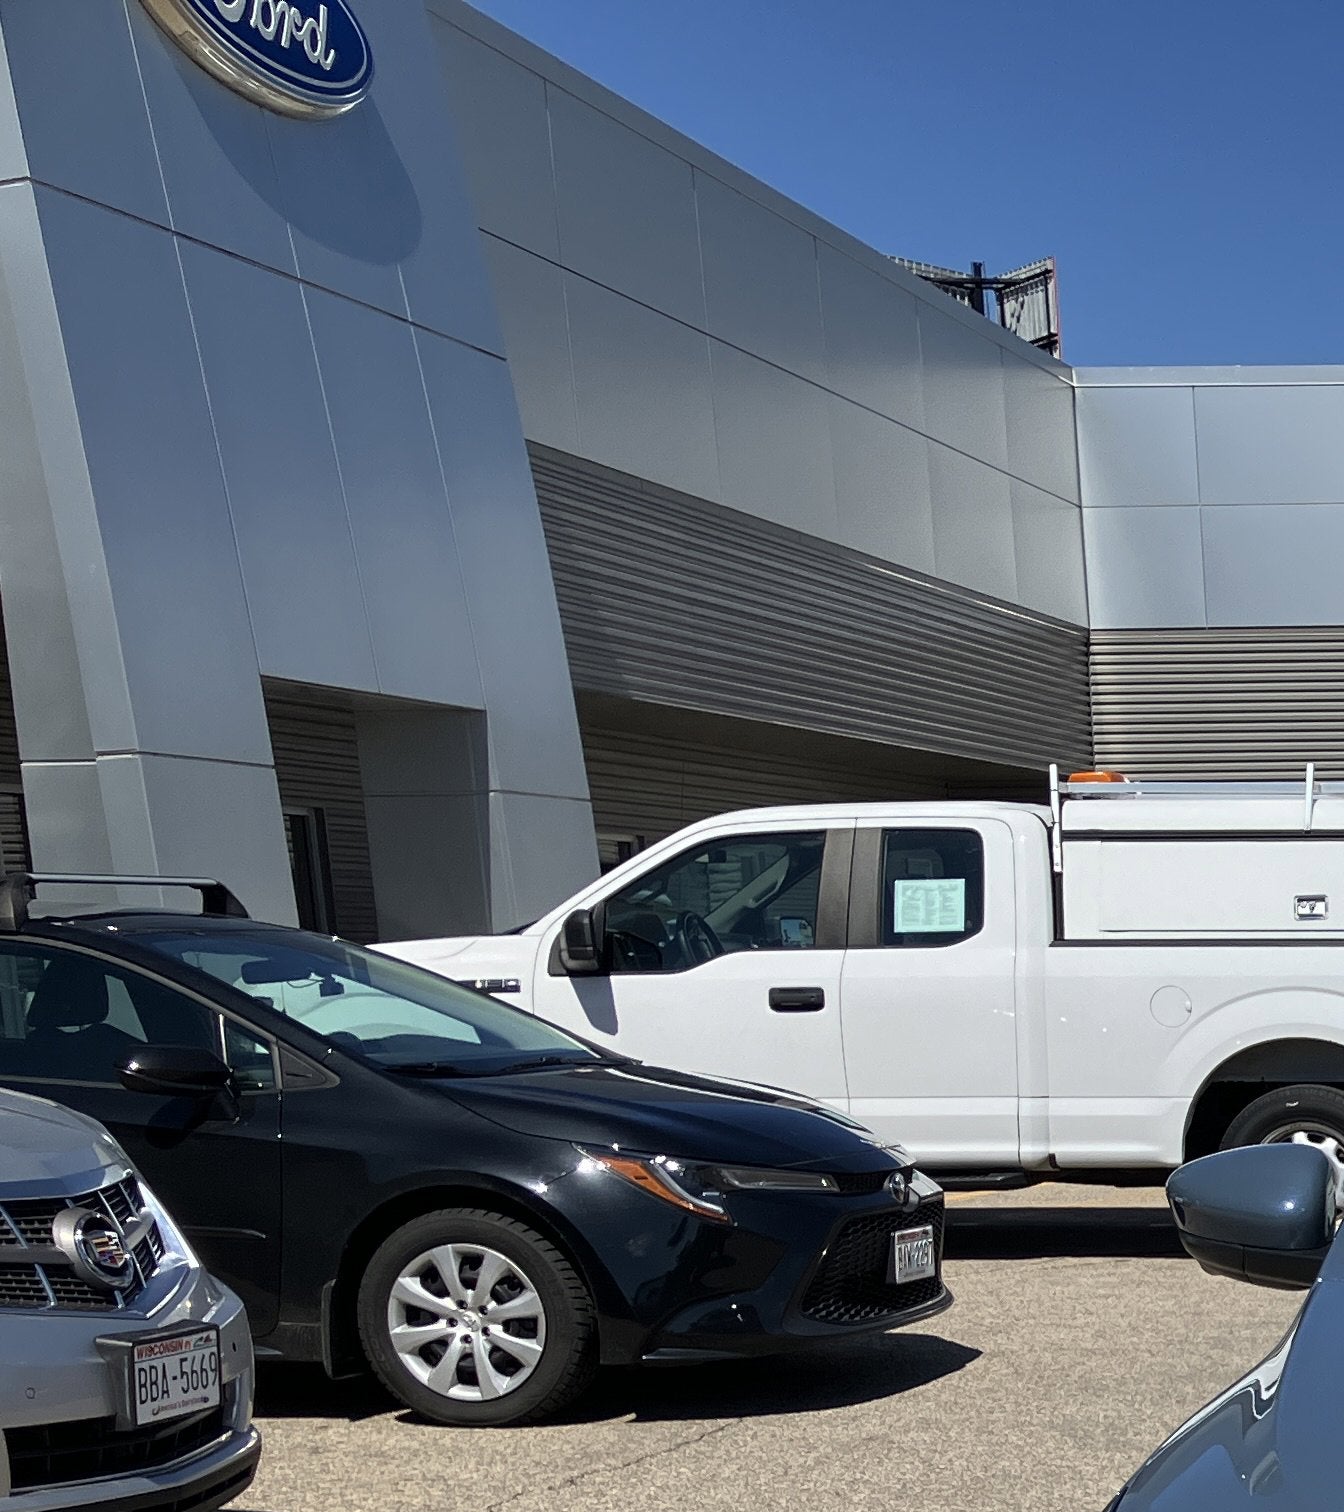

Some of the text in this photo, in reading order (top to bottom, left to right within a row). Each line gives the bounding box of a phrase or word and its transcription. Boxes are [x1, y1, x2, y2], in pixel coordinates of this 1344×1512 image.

[214, 0, 335, 71] ord
[136, 1339, 184, 1360] WISCONSIN
[138, 1351, 218, 1405] BBA-5669
